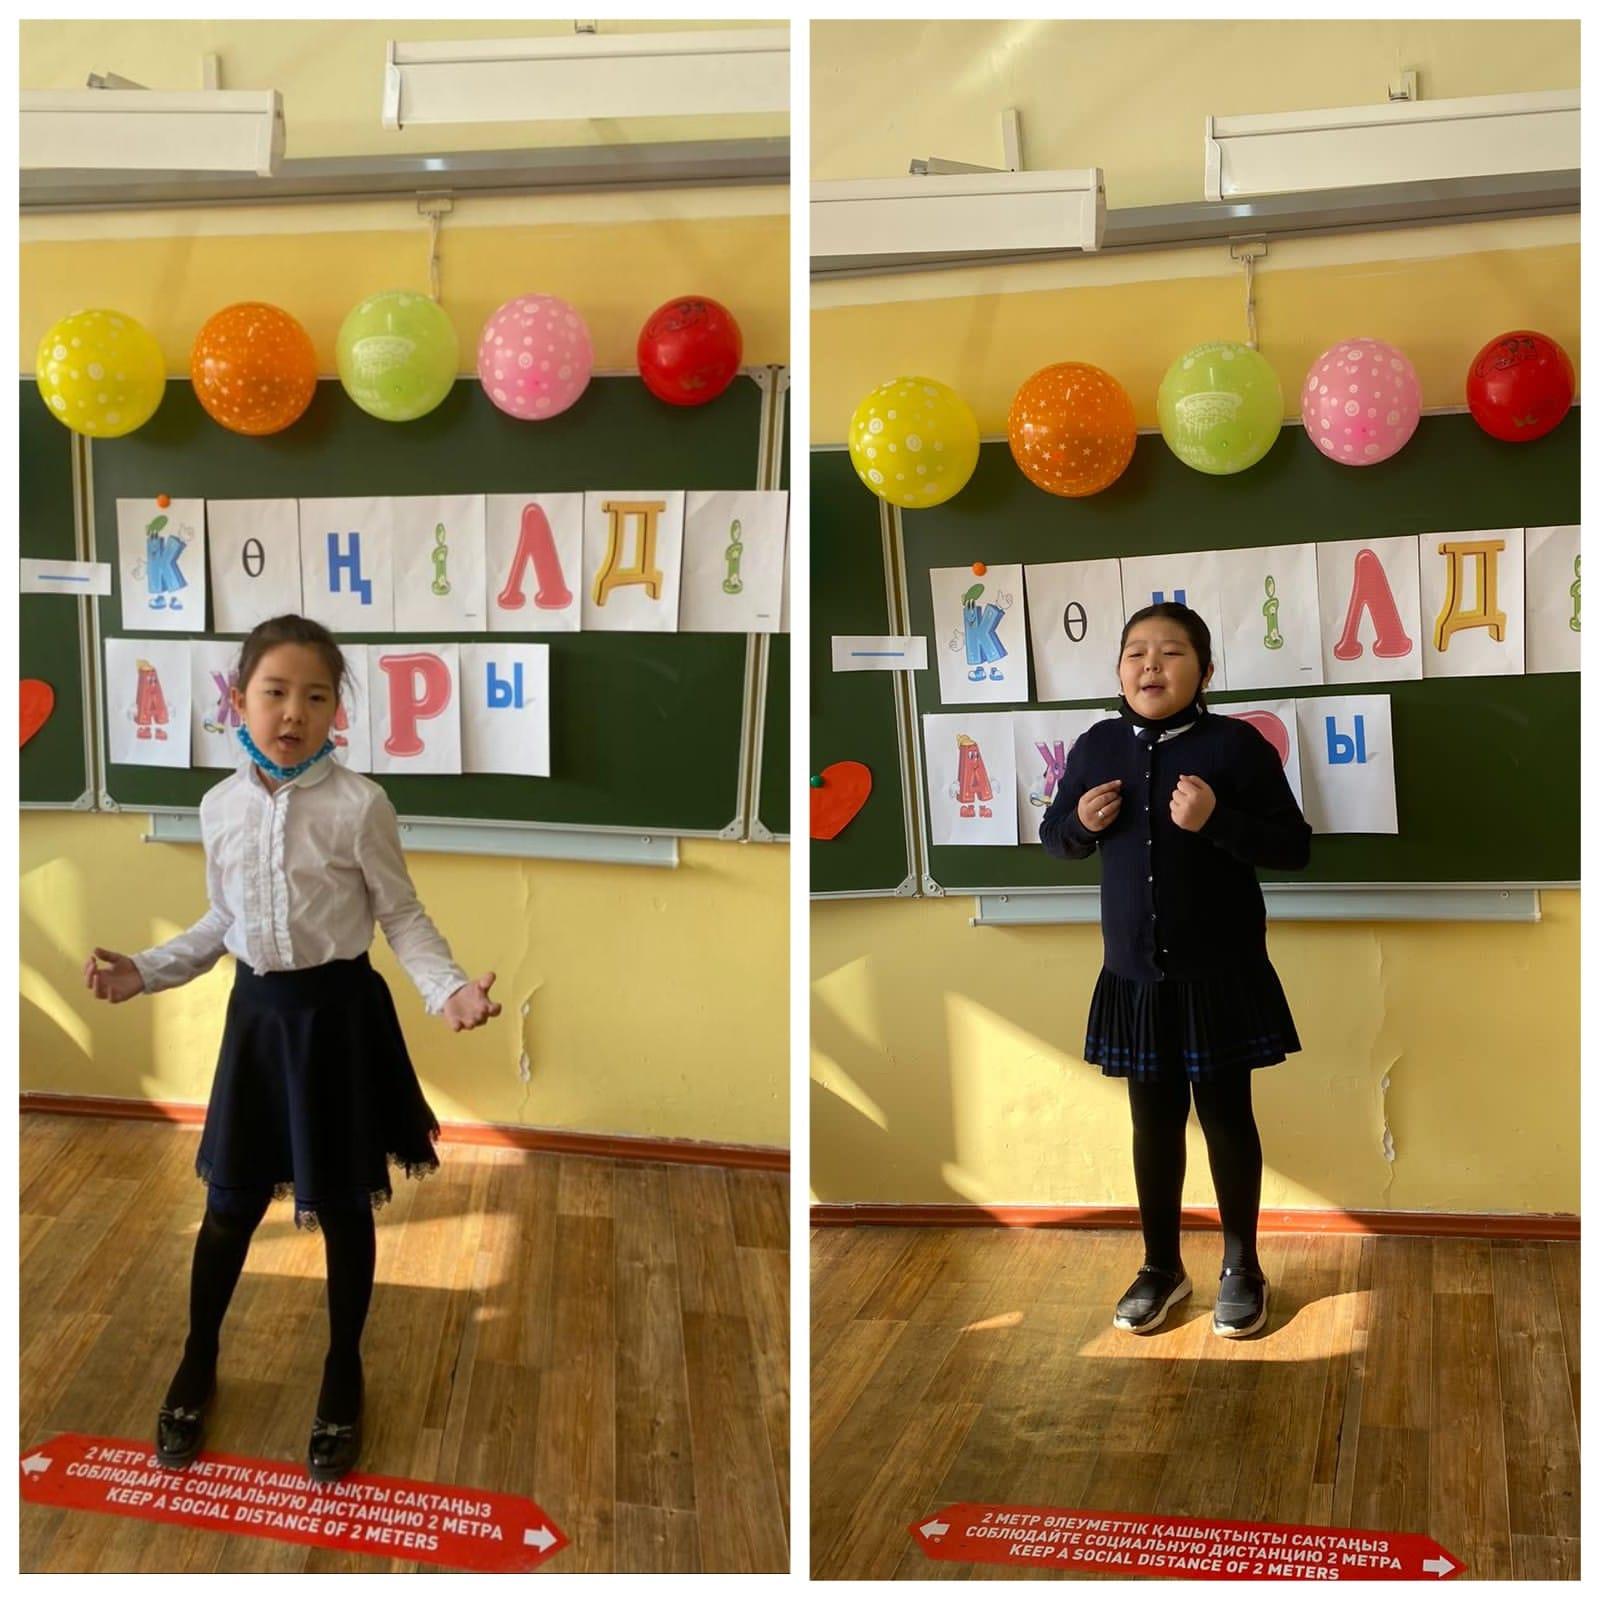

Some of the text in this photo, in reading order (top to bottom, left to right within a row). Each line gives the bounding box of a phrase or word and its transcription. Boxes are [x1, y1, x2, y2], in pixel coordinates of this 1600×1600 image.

[66, 1462, 503, 1541] СОБЛЮДАЙТЕ СОЦИАЛЬНУЮ ДИСТАНЦИЮ 2 МЕТРА
[85, 1445, 98, 1460] 2
[99, 1447, 146, 1465] МЕТР
[147, 1454, 253, 1482] ӘМЕТТІК
[394, 1489, 492, 1518] САҚТАҢЫЗ
[106, 1487, 439, 1550] KEEP A SOCIAL DISTANCE OF 2 METERS
[981, 1512, 1390, 1553] 2 МЕТР ӘЛЕУМЕТТІК ҚАШЫҚТЫҚТЫ САҚТАҢЫЗ
[965, 1526, 1402, 1570] СОБЛЮДАЙТЕ СОЦИАЛЬНУЮ ДИСТАНЦИЮ 2 МЕТРА
[1009, 1544, 1340, 1580] KEEP A SOCIAL DISTANCE OF 2 METERS
